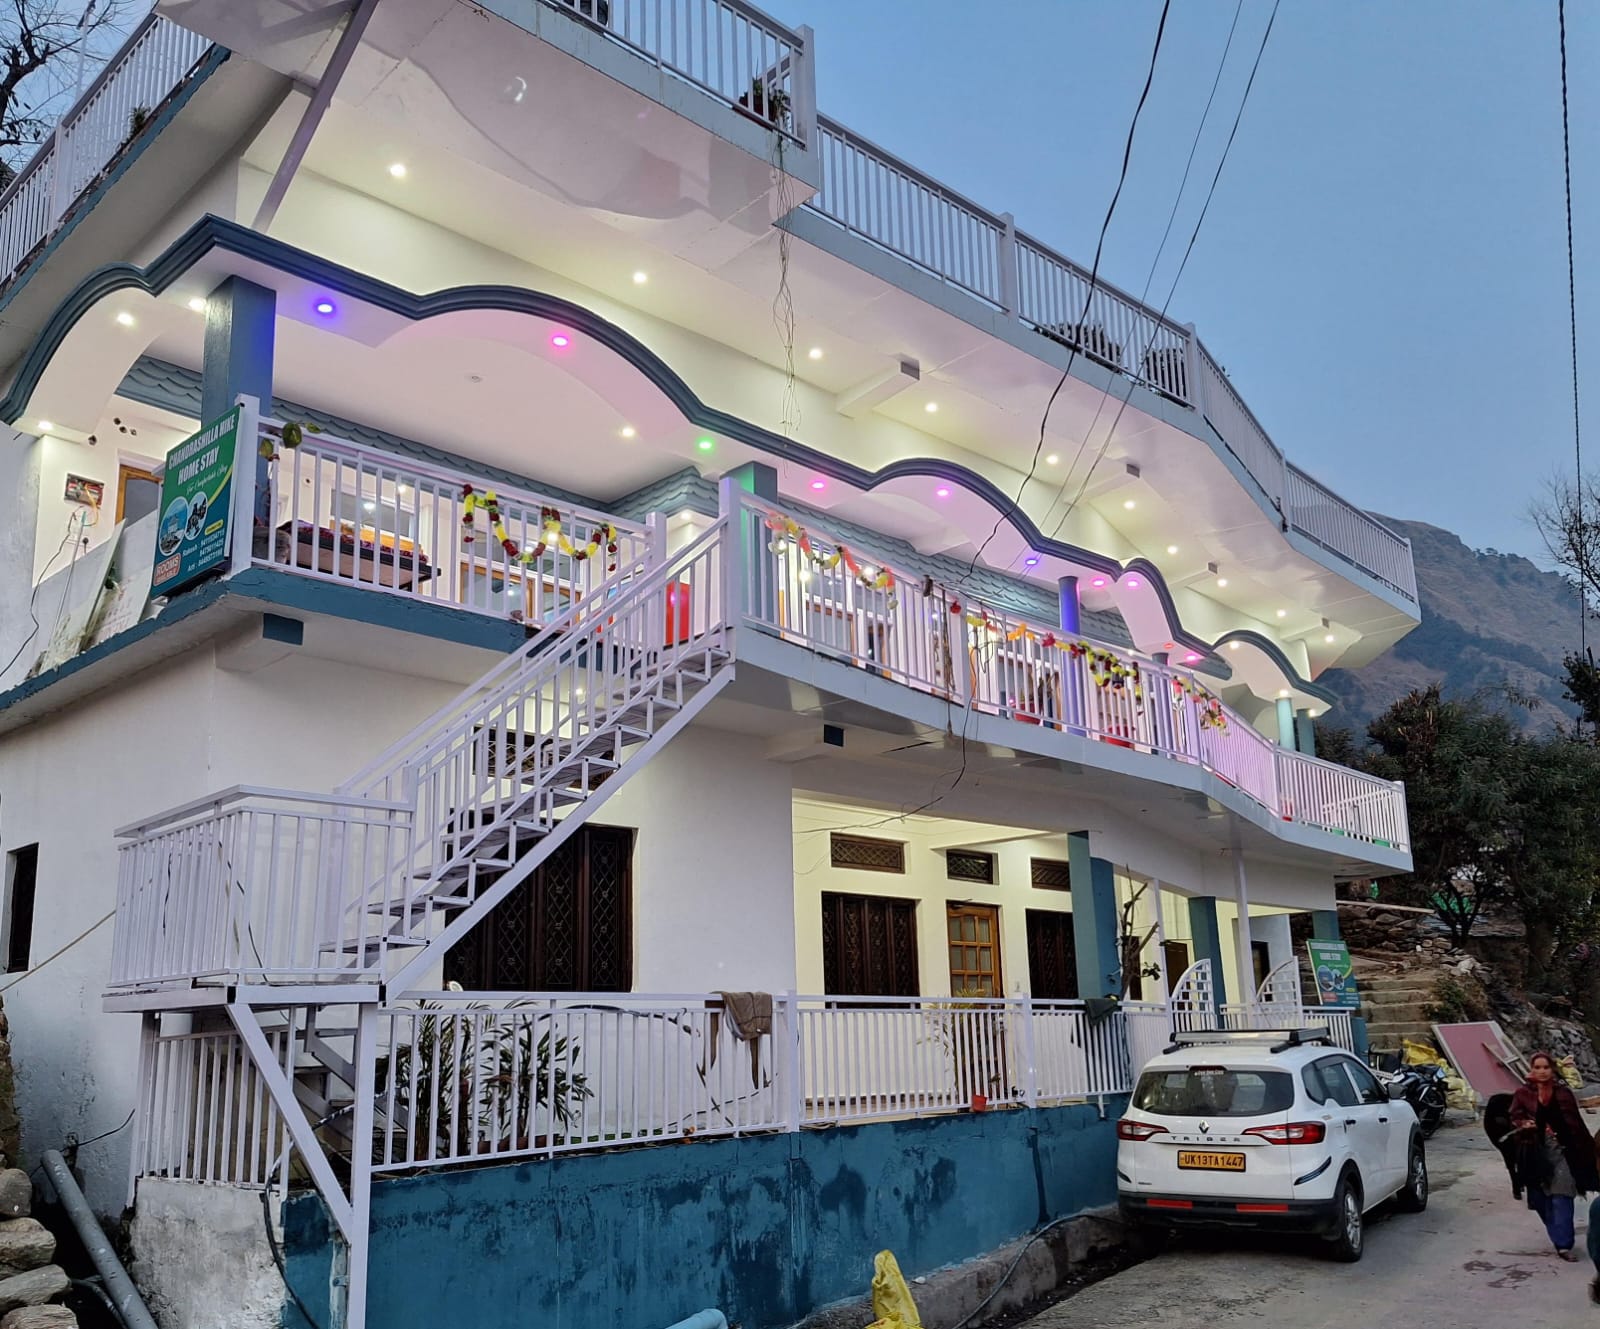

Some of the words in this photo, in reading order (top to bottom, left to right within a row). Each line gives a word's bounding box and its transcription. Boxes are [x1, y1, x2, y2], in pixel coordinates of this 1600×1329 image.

[178, 458, 200, 486] HOME
[200, 445, 220, 472] STAY
[156, 555, 180, 575] ROOMS
[1184, 1153, 1244, 1167] UK13TA1447
